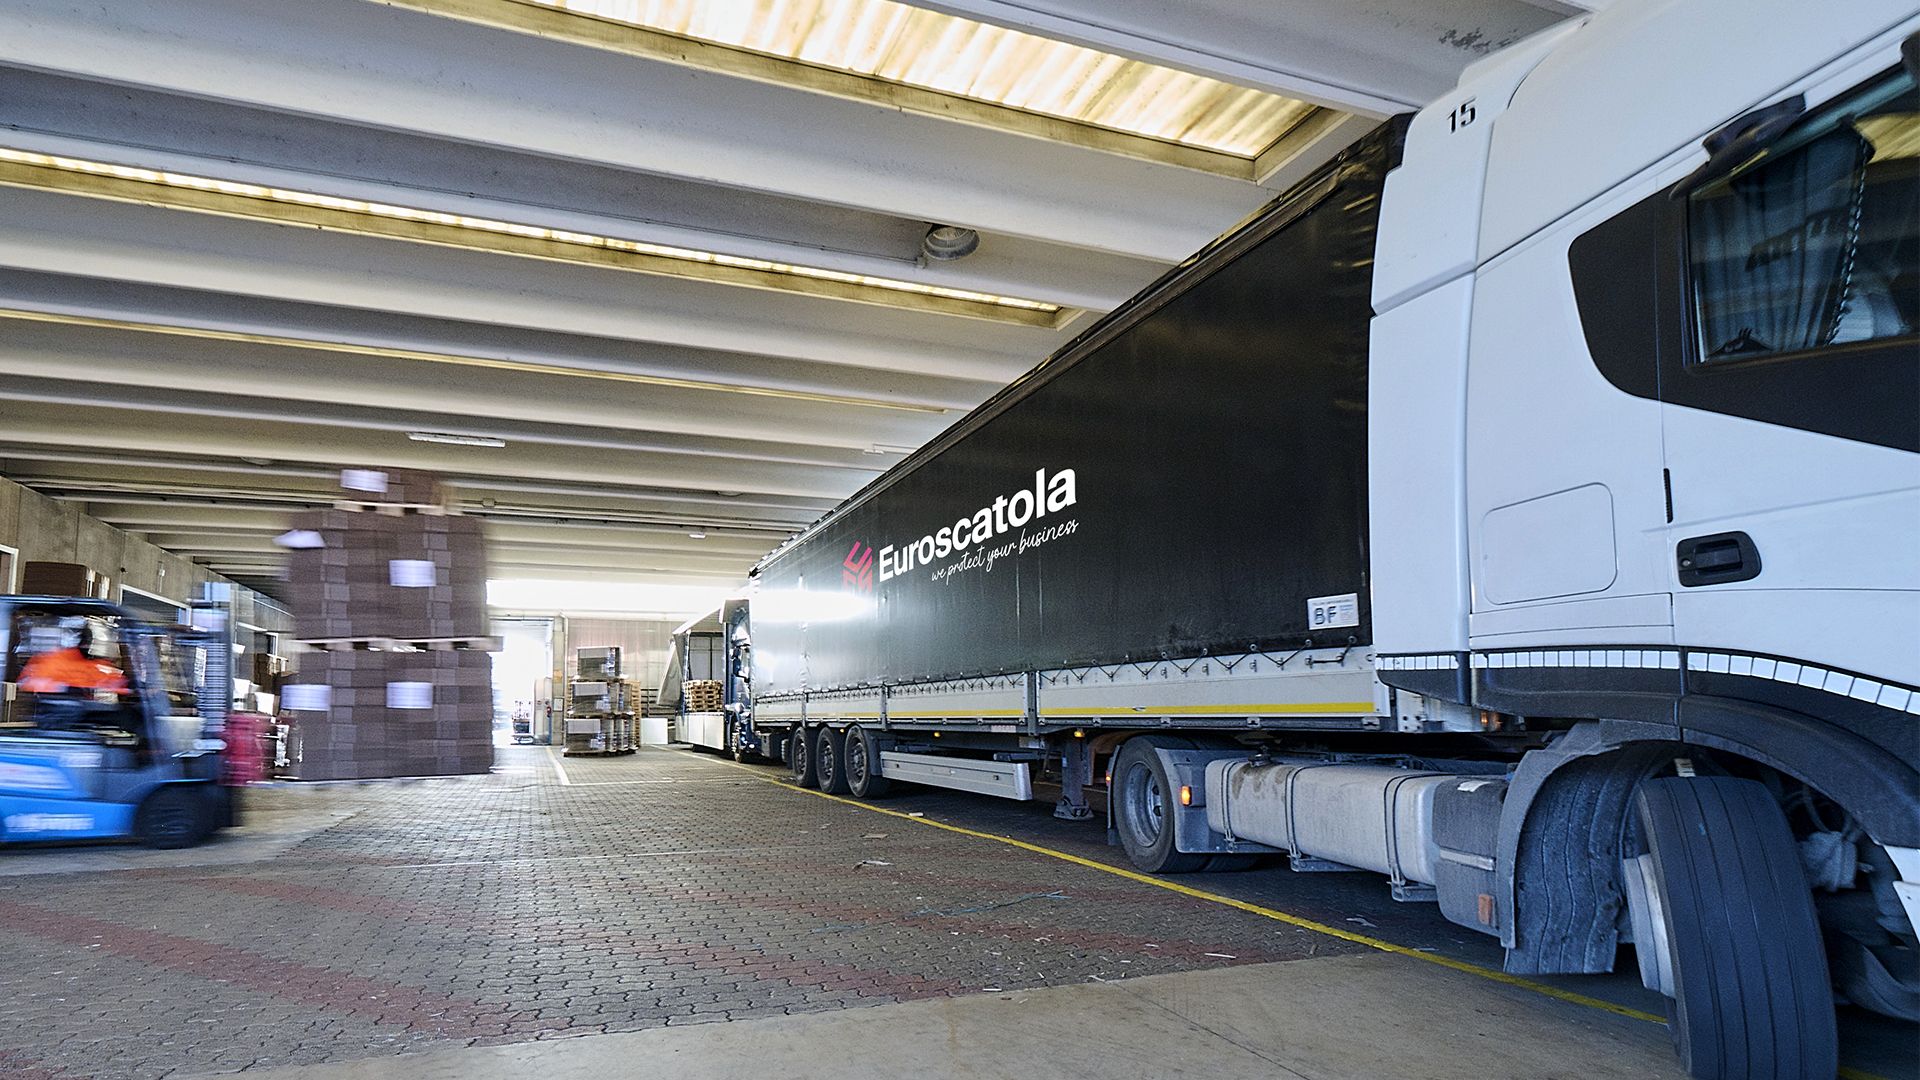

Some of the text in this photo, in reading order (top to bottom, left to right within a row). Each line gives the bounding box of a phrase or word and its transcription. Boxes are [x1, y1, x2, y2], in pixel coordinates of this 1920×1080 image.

[1447, 98, 1476, 133] 15
[879, 468, 1077, 582] Euroscatola
[931, 519, 1079, 585] we protect your business
